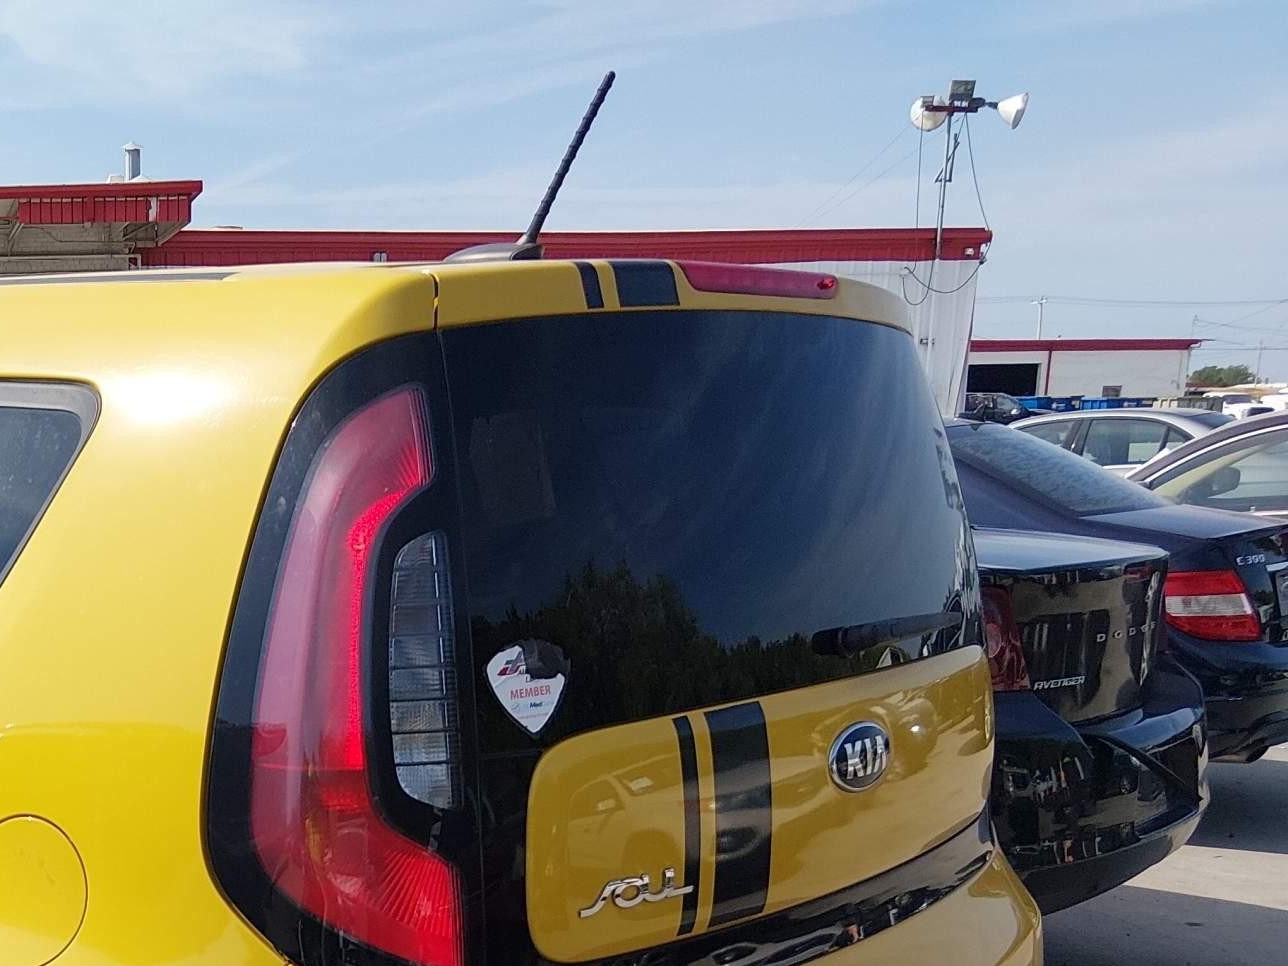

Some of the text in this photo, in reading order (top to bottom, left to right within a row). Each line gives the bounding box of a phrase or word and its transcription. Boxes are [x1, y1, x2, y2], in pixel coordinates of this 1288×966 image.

[510, 685, 552, 700] MEMBER
[1033, 676, 1085, 691] AVENGER
[843, 735, 888, 780] KIA
[578, 867, 695, 919] SOUL
